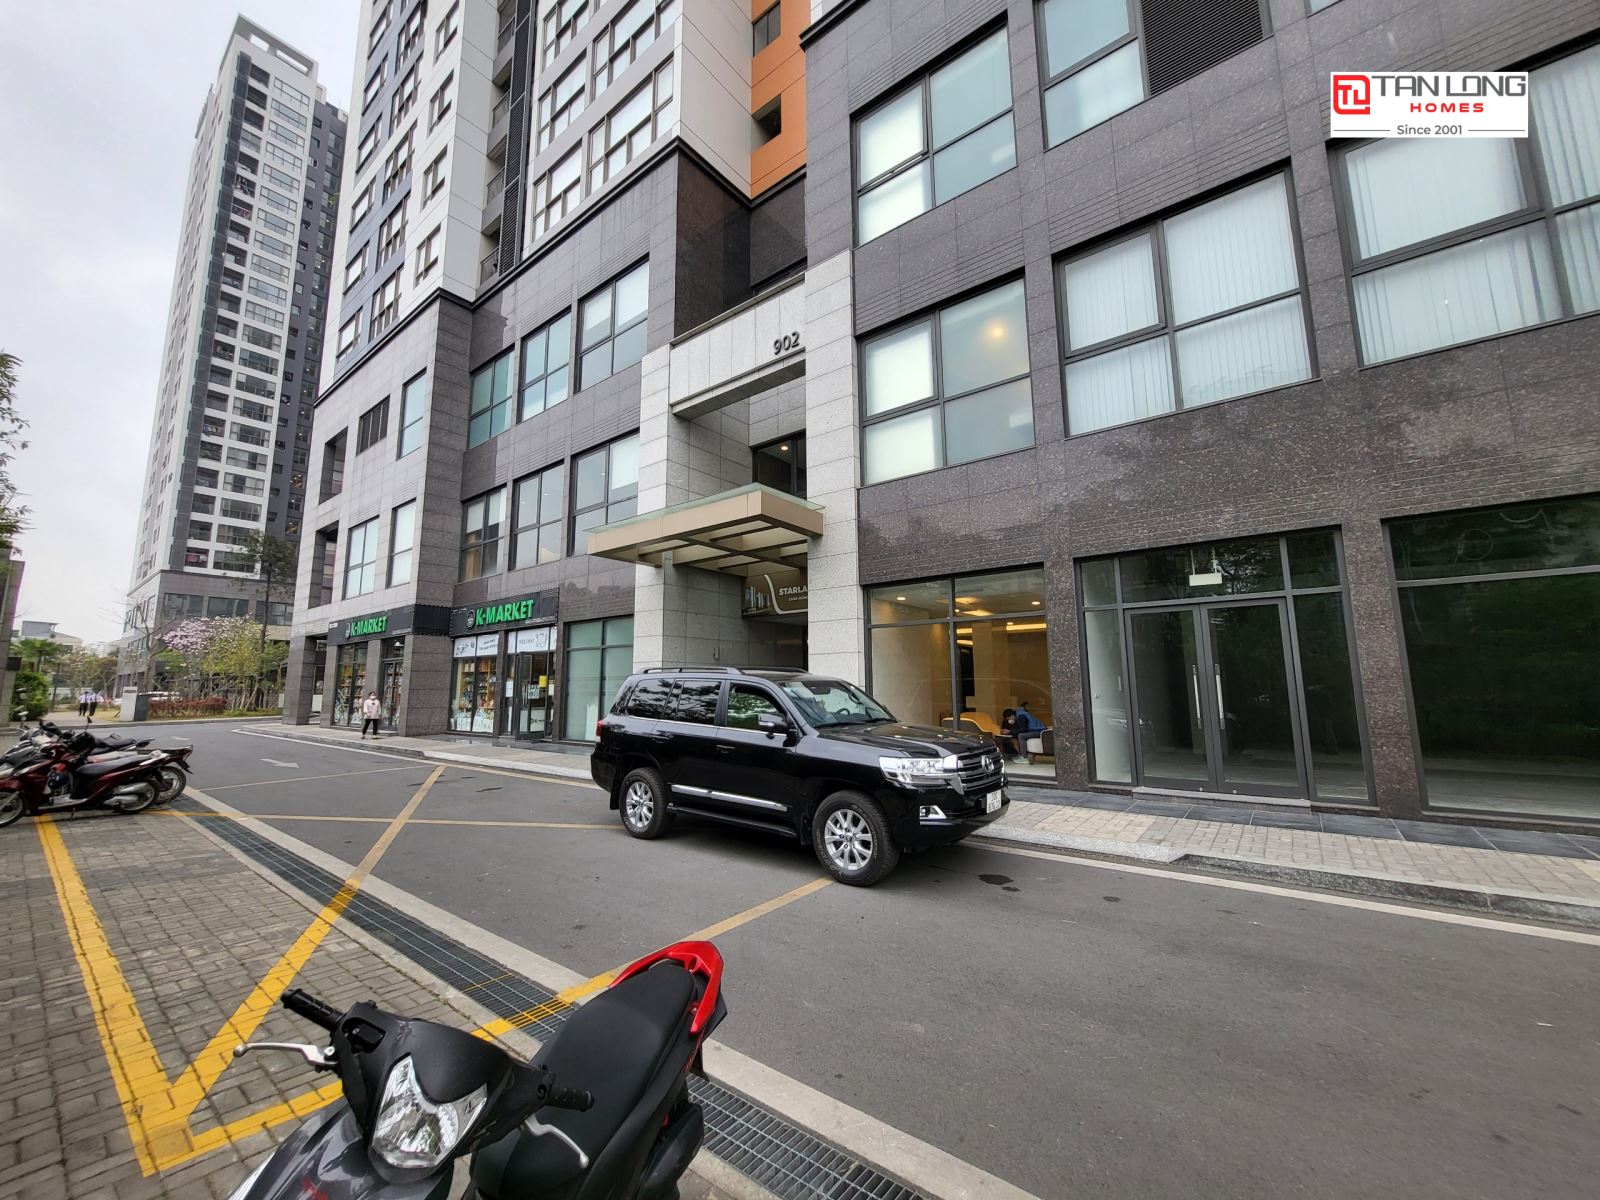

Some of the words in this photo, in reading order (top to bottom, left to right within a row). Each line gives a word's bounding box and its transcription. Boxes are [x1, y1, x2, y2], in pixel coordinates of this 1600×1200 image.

[773, 330, 800, 356] 902
[779, 585, 808, 596] STARLA
[475, 599, 534, 626] K-MARKET
[350, 615, 388, 637] K-MARKET
